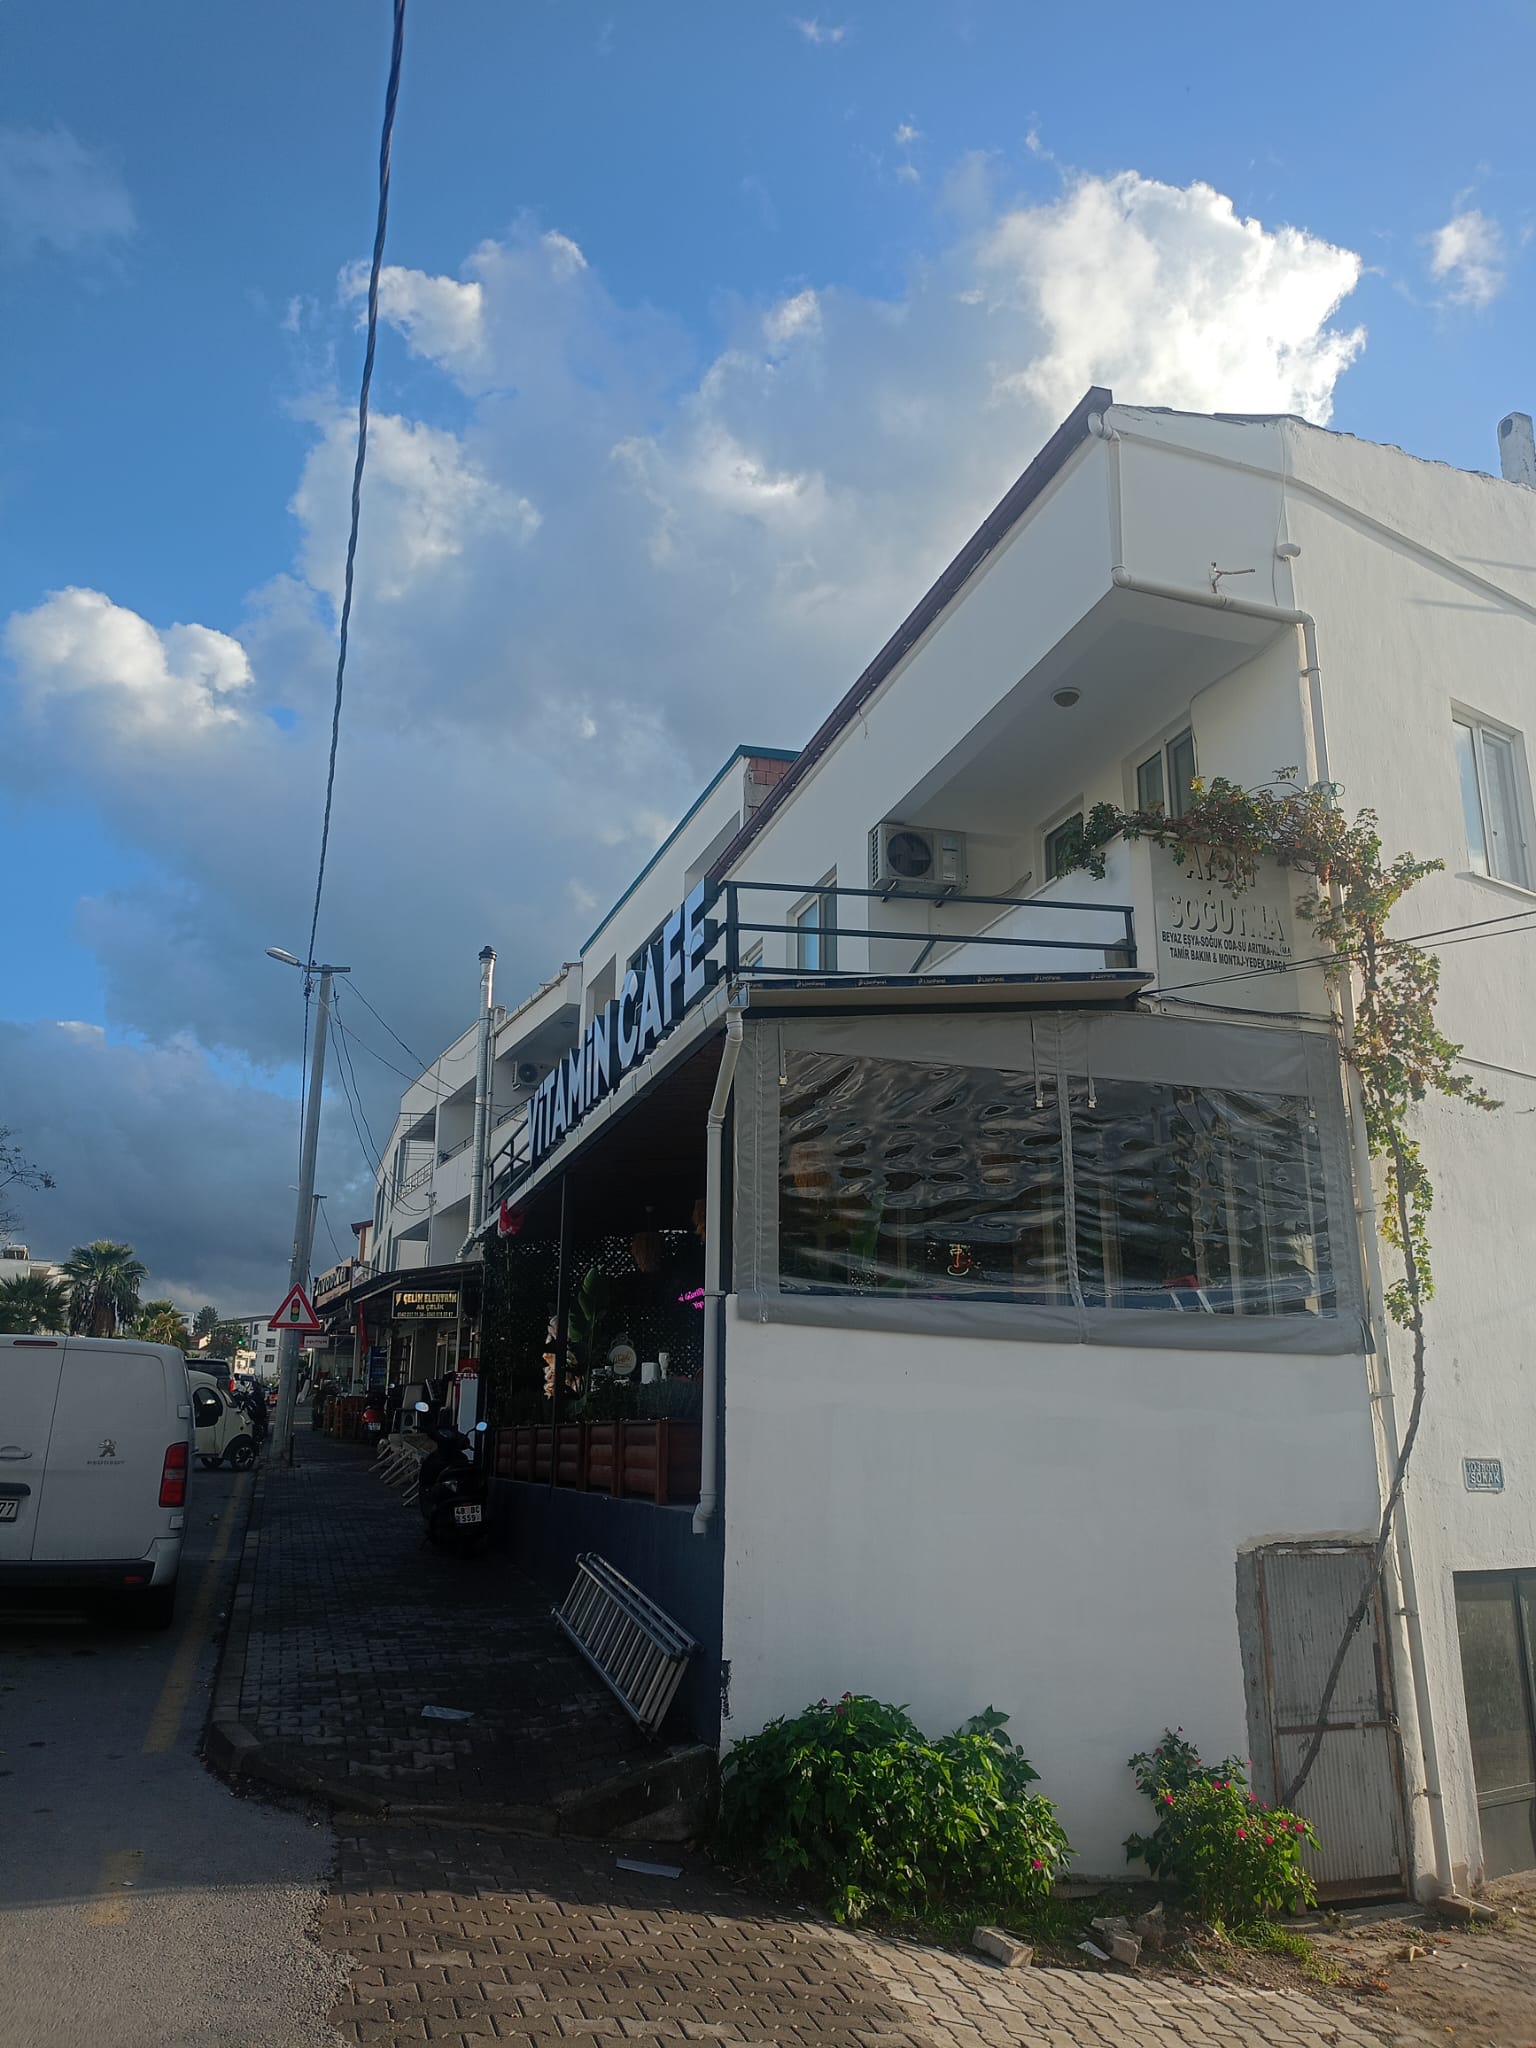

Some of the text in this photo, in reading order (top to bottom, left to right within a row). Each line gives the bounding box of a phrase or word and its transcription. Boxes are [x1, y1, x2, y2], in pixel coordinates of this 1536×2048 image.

[1161, 930, 1183, 944] BEYAZ
[1183, 933, 1223, 950] EŞYA-SOĞUK
[1223, 939, 1247, 953] ODA-SU
[1169, 945, 1288, 973] TAMİR BAKIM & MONTAJ-YEDEK PARÇA
[617, 880, 714, 1070] CAFE
[1470, 1472, 1501, 1483] SOKAK
[462, 1514, 476, 1522] 559
